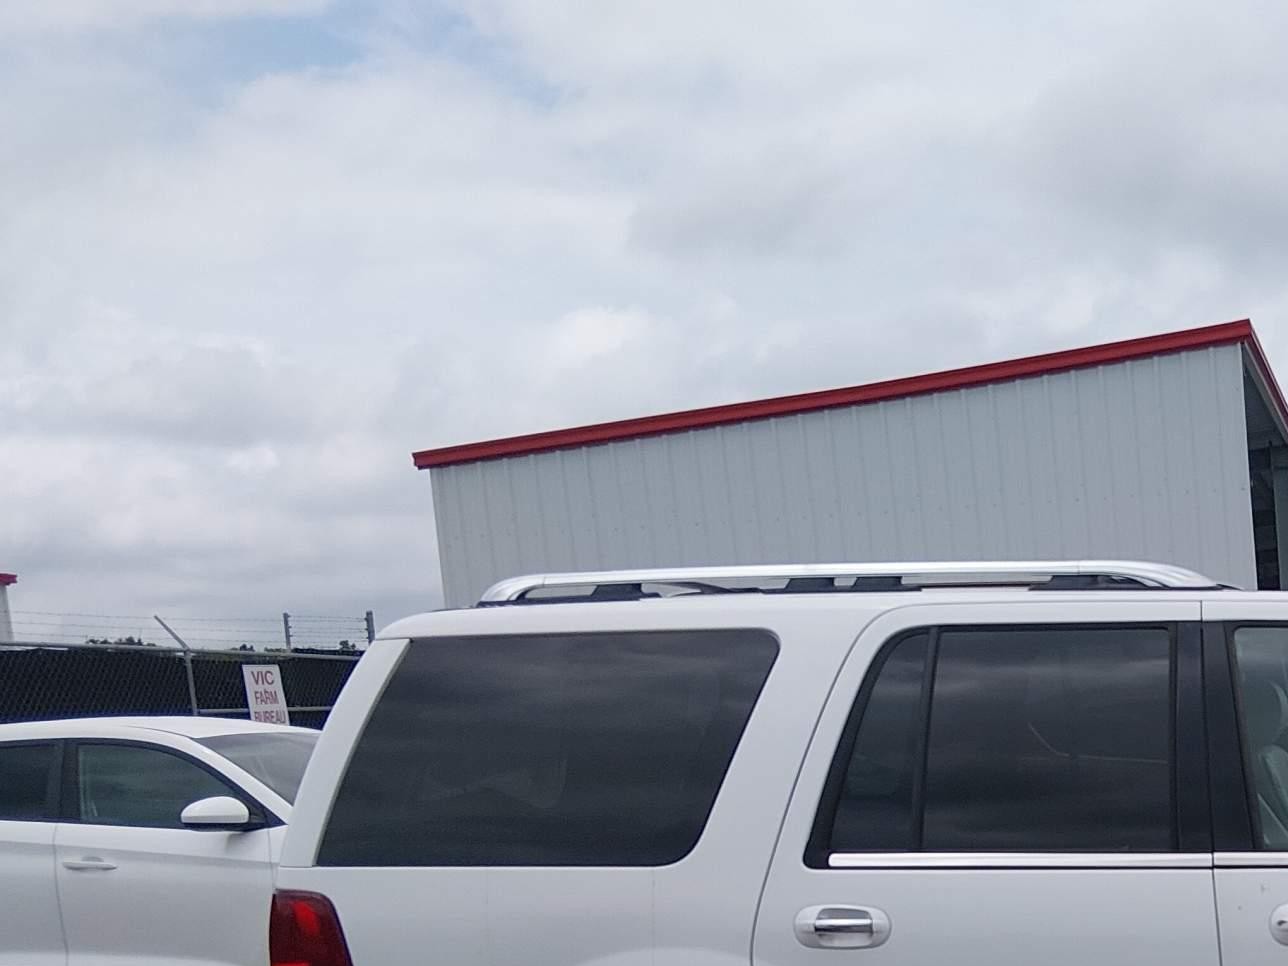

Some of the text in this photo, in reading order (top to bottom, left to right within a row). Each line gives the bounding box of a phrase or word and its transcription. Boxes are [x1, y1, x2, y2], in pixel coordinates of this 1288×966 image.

[250, 670, 275, 686] VIC
[254, 689, 280, 705] FARM
[254, 709, 287, 724] BUREAU
